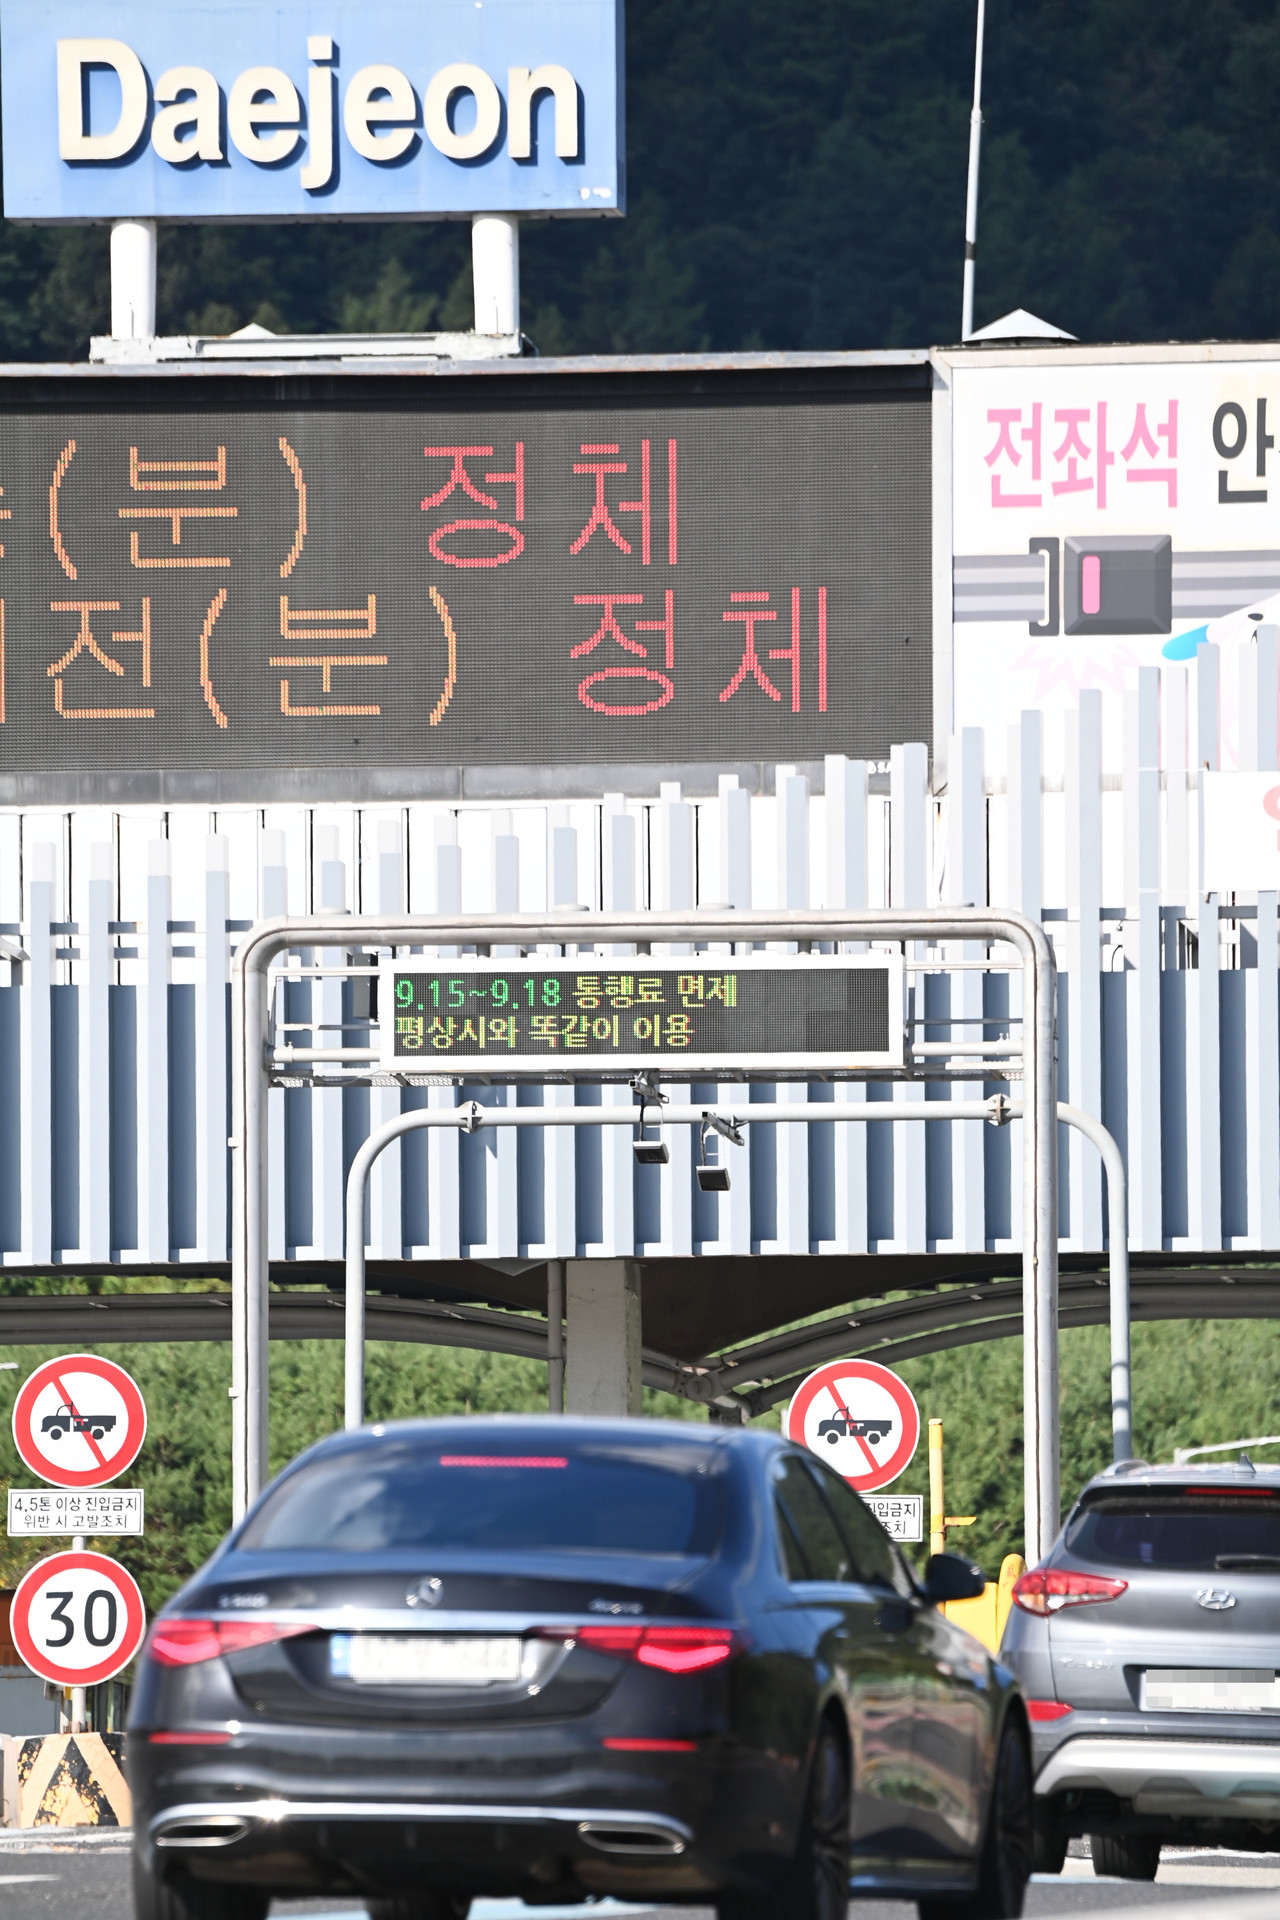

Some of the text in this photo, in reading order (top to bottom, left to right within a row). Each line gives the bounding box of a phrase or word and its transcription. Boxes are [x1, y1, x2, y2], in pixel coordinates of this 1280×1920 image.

[57, 36, 580, 191] Daejeon
[984, 397, 1280, 510] 전좌석 안
[0, 437, 307, 580] (분)
[0, 585, 457, 729] 전(분)
[395, 974, 737, 1011] 9.15~9.18 통행료 면제
[394, 1013, 696, 1049] 평상시와 똑같이 이용
[14, 1496, 137, 1512] 4.5톤 이상 진입금지
[23, 1514, 128, 1529] 위반 시 고발조치
[45, 1589, 118, 1648] 30
